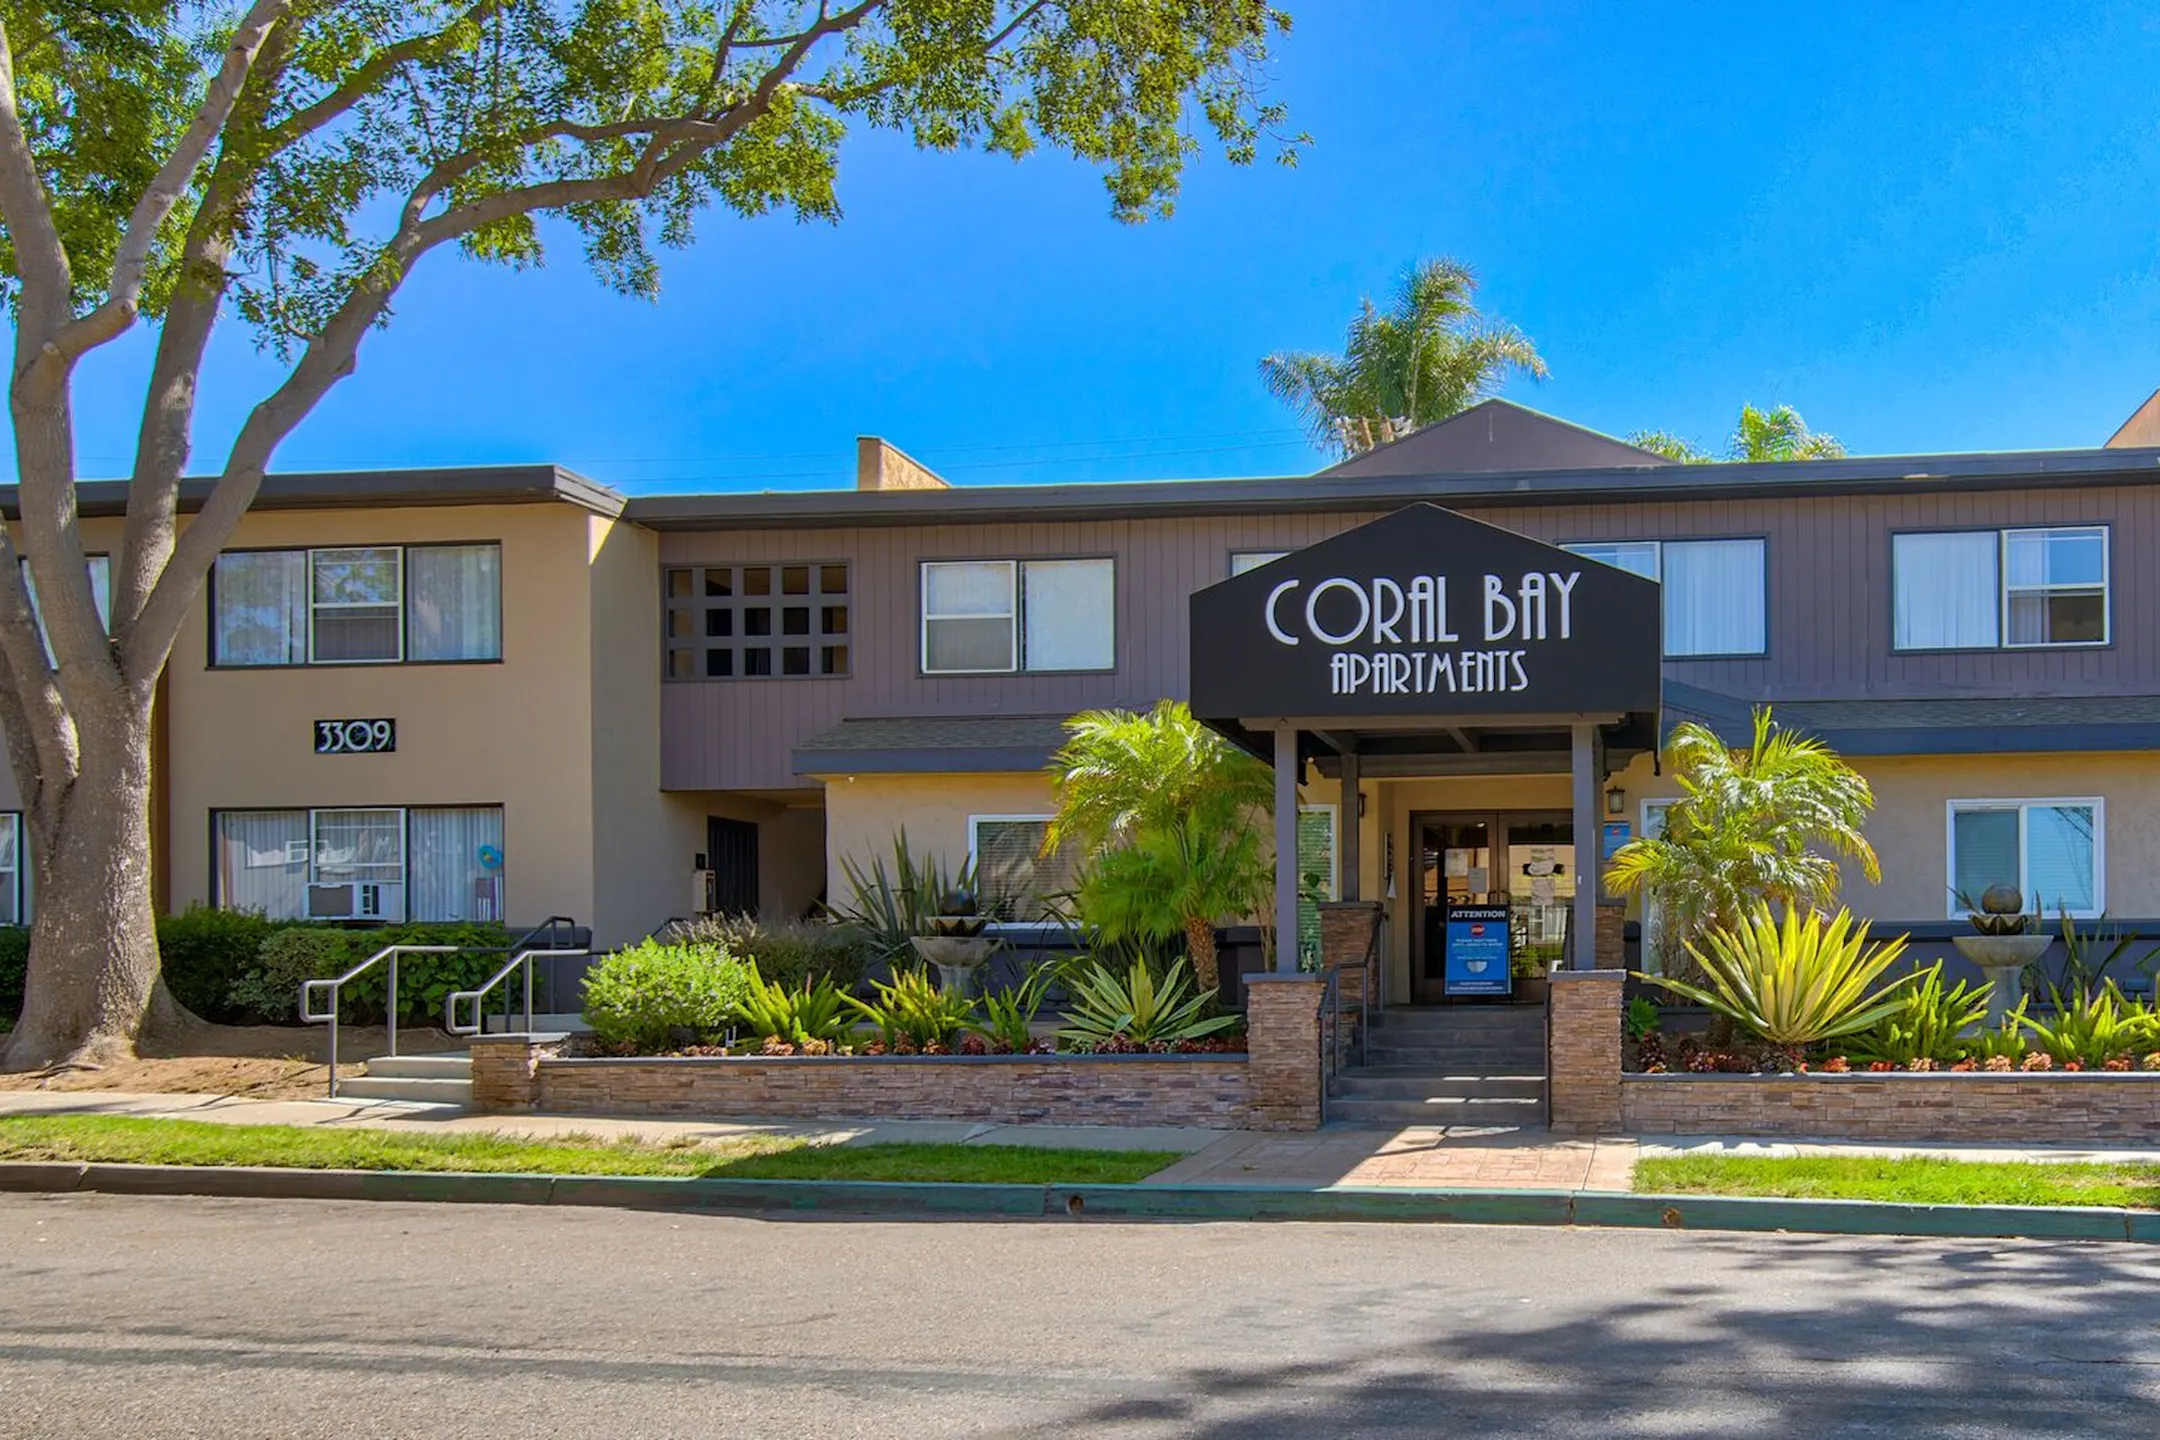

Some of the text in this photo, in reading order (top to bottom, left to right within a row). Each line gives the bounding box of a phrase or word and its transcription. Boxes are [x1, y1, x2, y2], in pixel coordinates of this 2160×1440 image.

[1265, 571, 1581, 645] CORAL BAY
[1330, 650, 1529, 694] APARTMENTS
[318, 720, 391, 752] 3309
[1451, 910, 1506, 919] ATTENTION
